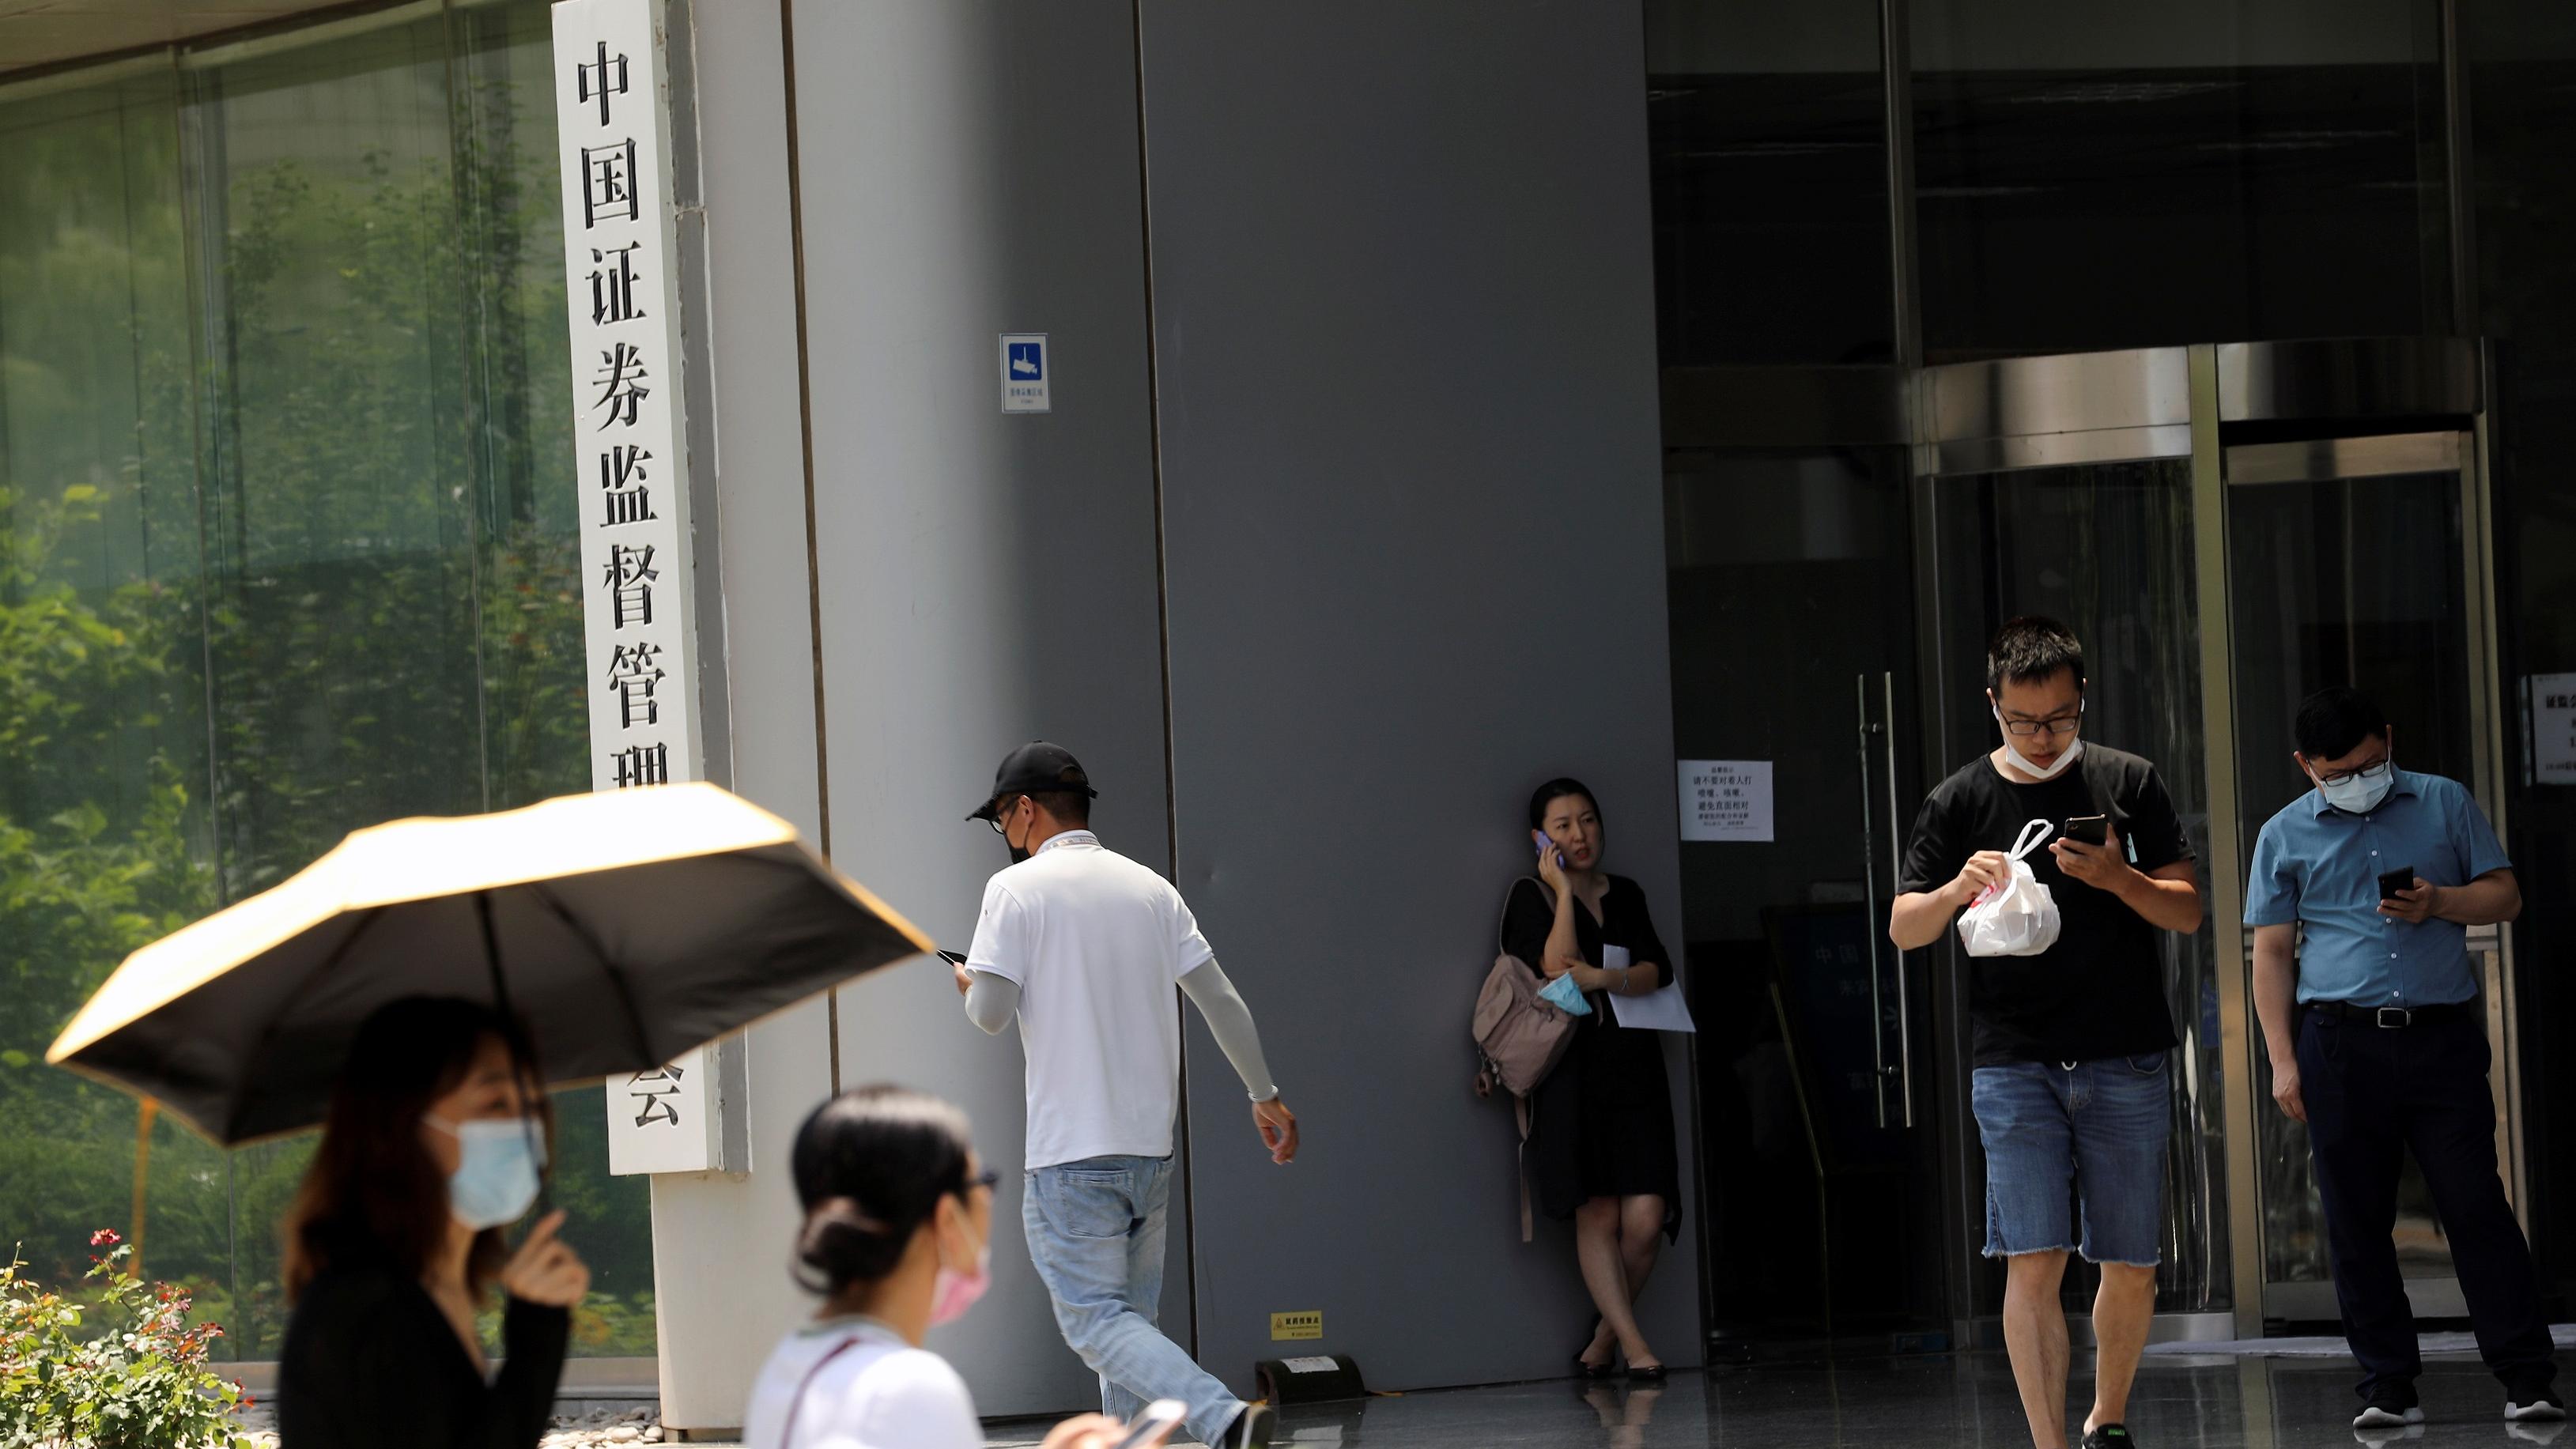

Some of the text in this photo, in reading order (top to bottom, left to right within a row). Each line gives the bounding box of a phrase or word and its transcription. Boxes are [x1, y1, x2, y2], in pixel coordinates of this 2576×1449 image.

[578, 40, 686, 1129] 中国证券监督管理会
